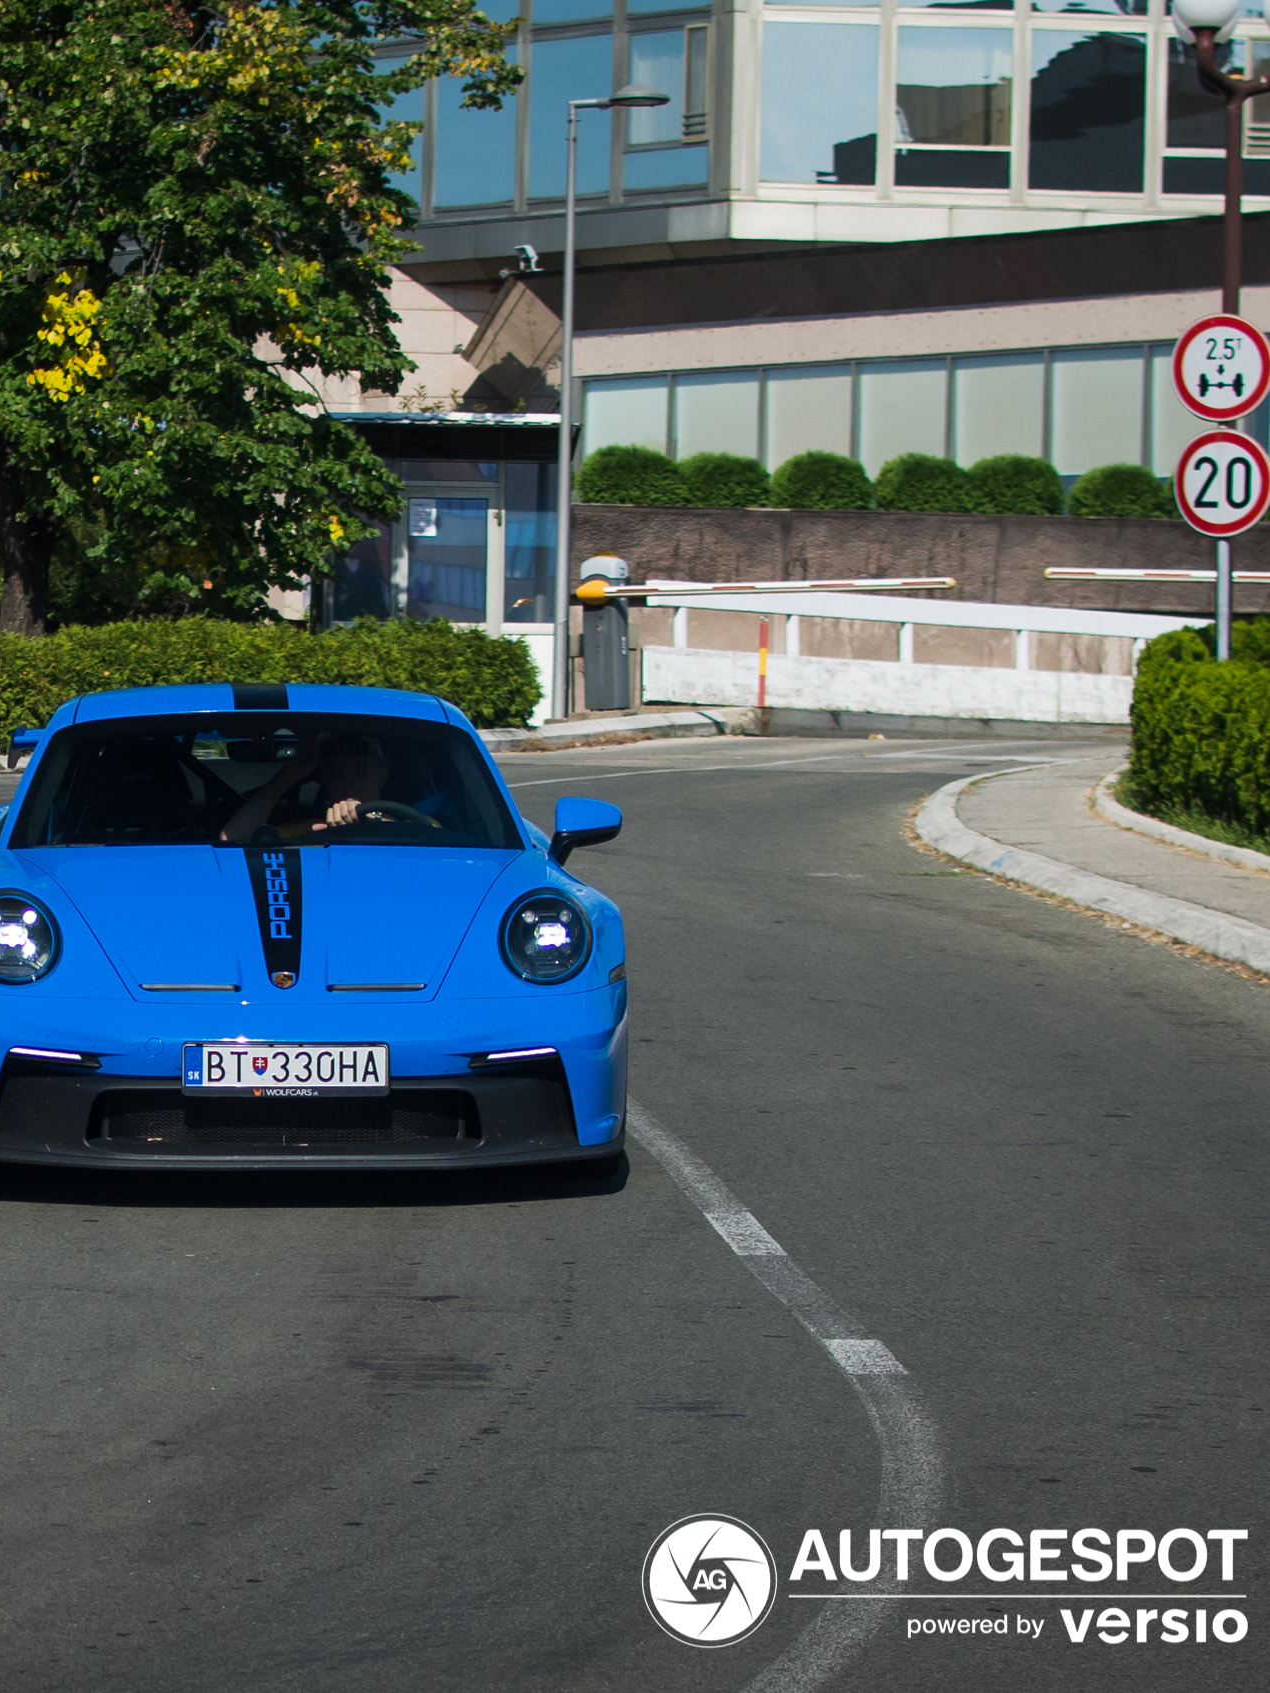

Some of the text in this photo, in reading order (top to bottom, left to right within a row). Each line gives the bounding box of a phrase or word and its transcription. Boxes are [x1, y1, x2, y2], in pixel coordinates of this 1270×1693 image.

[1193, 456, 1252, 508] 20
[262, 852, 292, 938] PORSCHE
[187, 1071, 200, 1080] SK
[207, 1051, 380, 1083] BT 330HA
